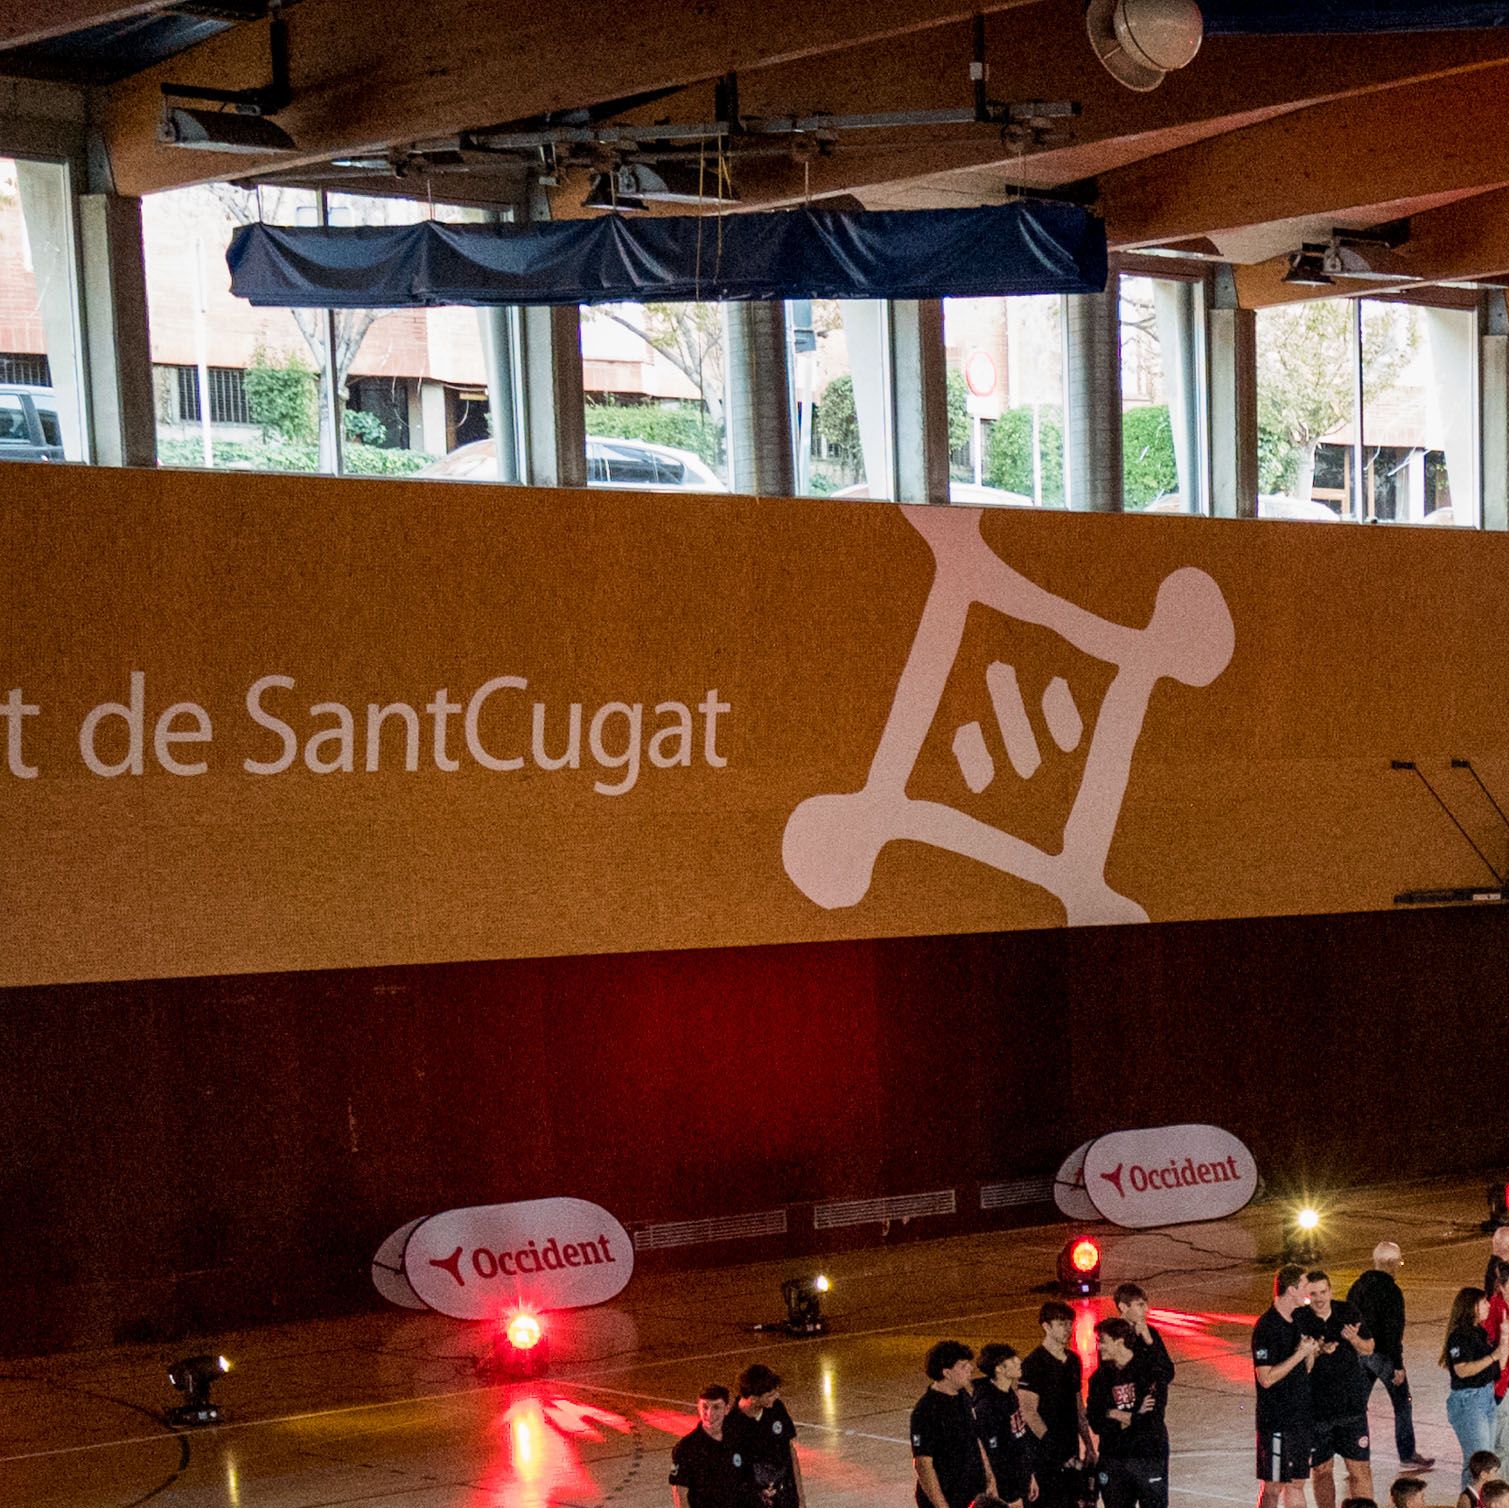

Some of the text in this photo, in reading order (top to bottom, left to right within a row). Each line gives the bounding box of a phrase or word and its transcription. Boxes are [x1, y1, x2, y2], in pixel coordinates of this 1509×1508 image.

[80, 672, 213, 777] de
[1129, 1156, 1241, 1193] Occident
[472, 1234, 616, 1279] Occident
